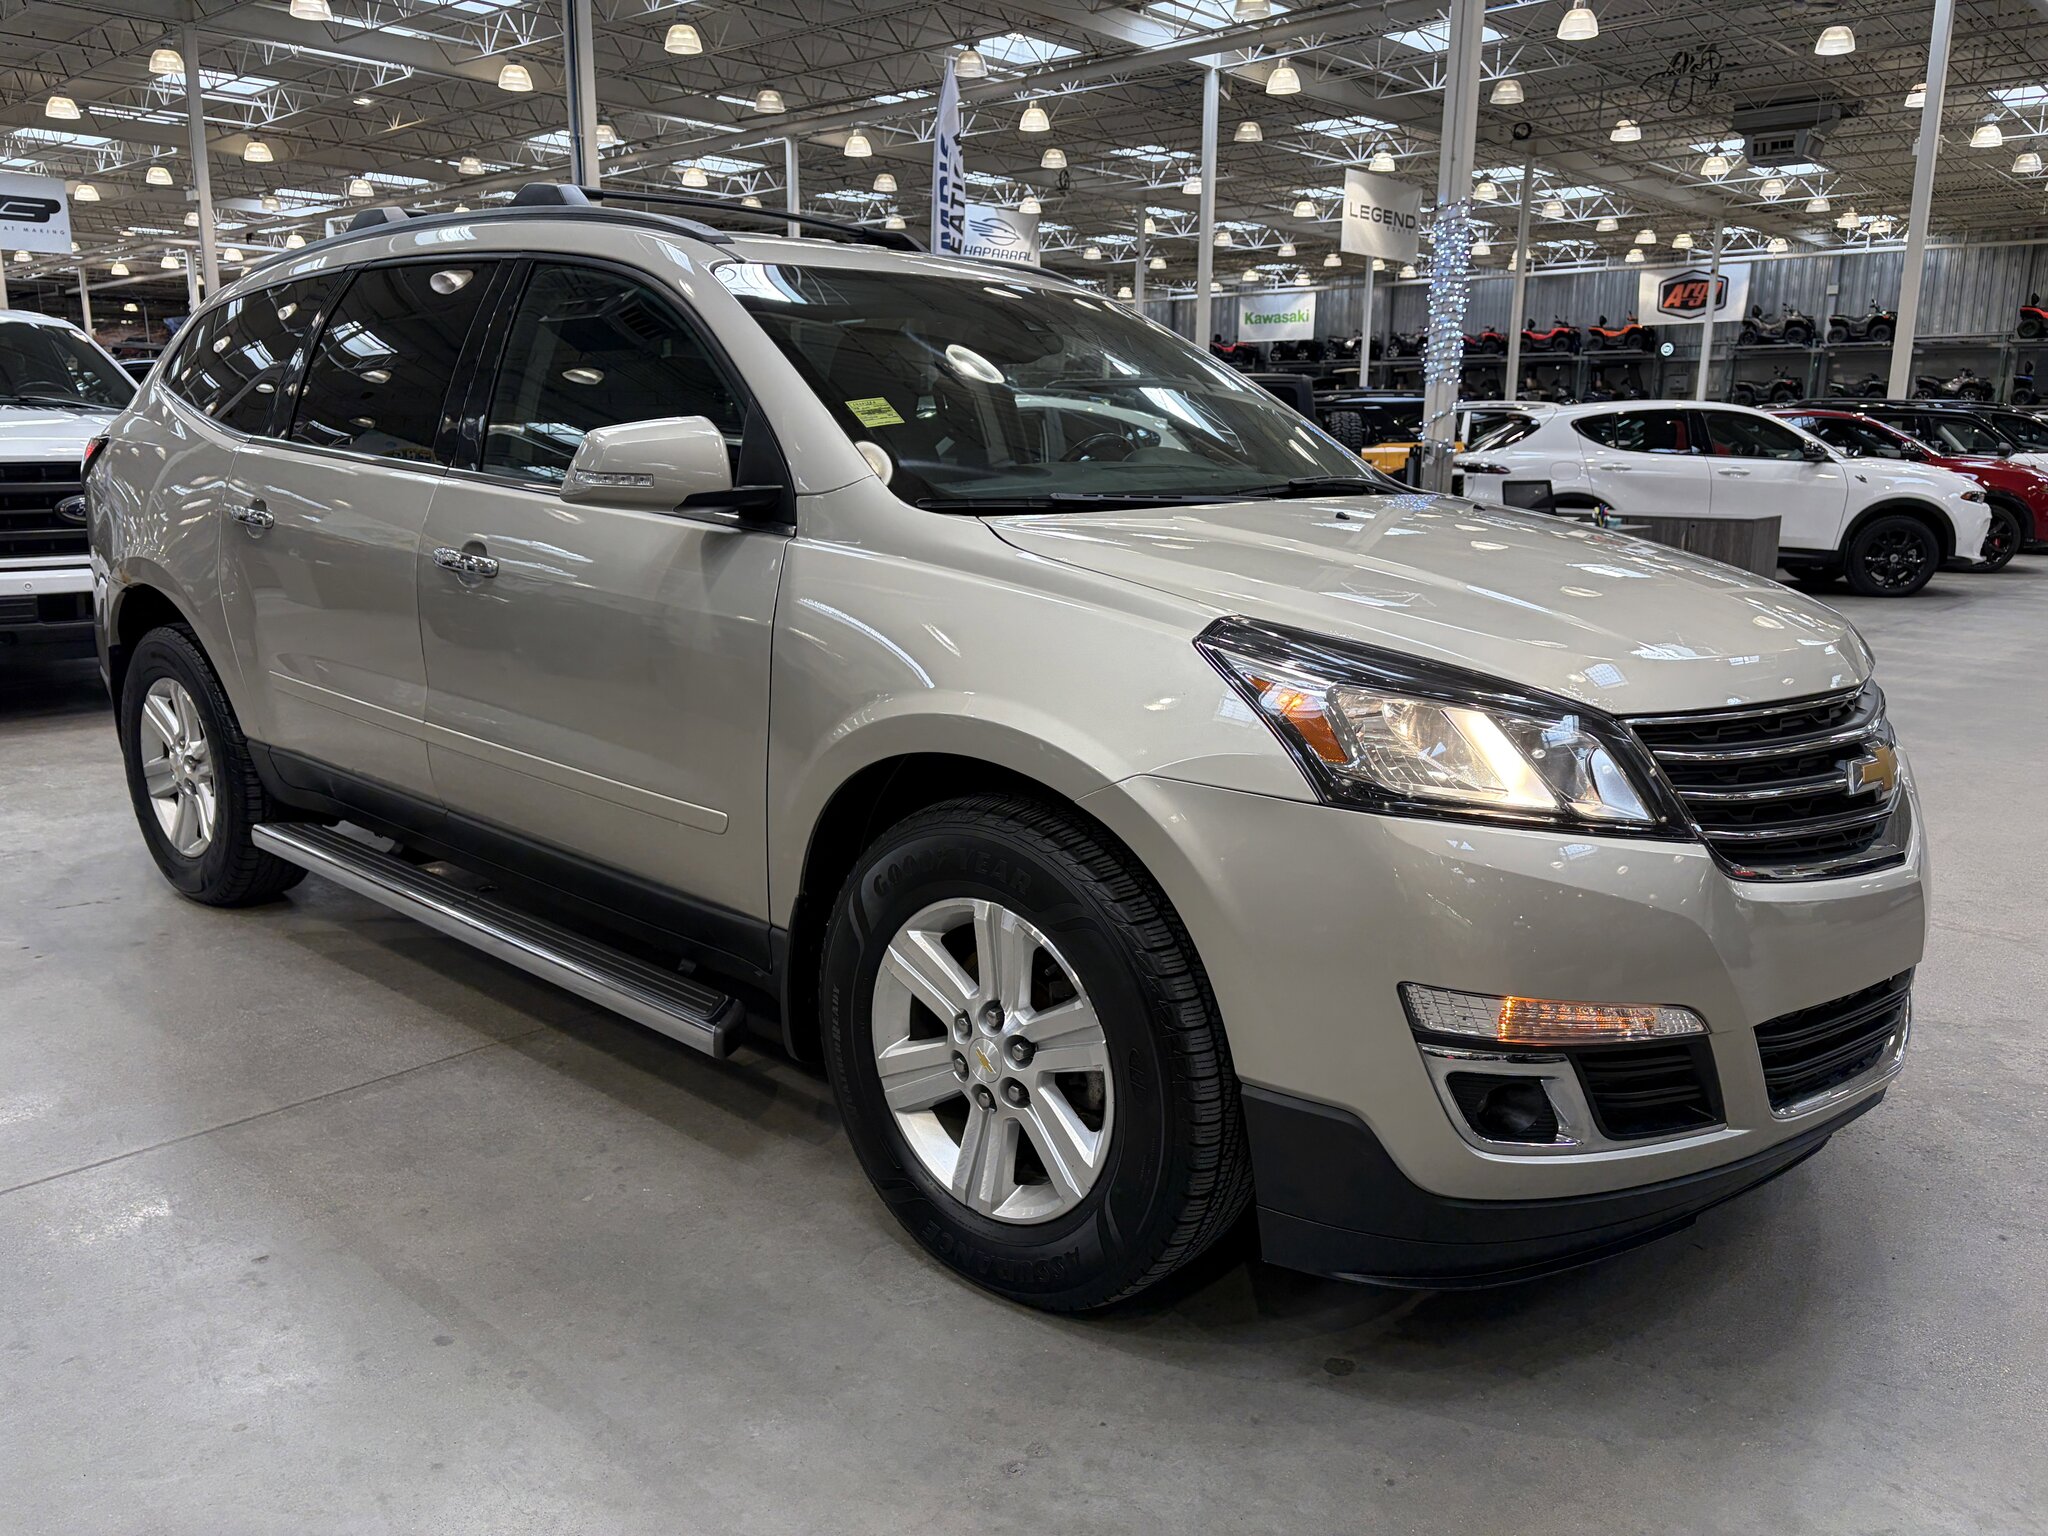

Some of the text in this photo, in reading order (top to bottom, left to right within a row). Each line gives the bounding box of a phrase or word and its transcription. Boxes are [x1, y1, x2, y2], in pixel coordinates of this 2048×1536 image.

[1349, 201, 1417, 229] LEGEND
[23, 227, 66, 235] MAKING
[964, 245, 1034, 262] HAPARRAL
[1244, 309, 1310, 325] Kawasaki
